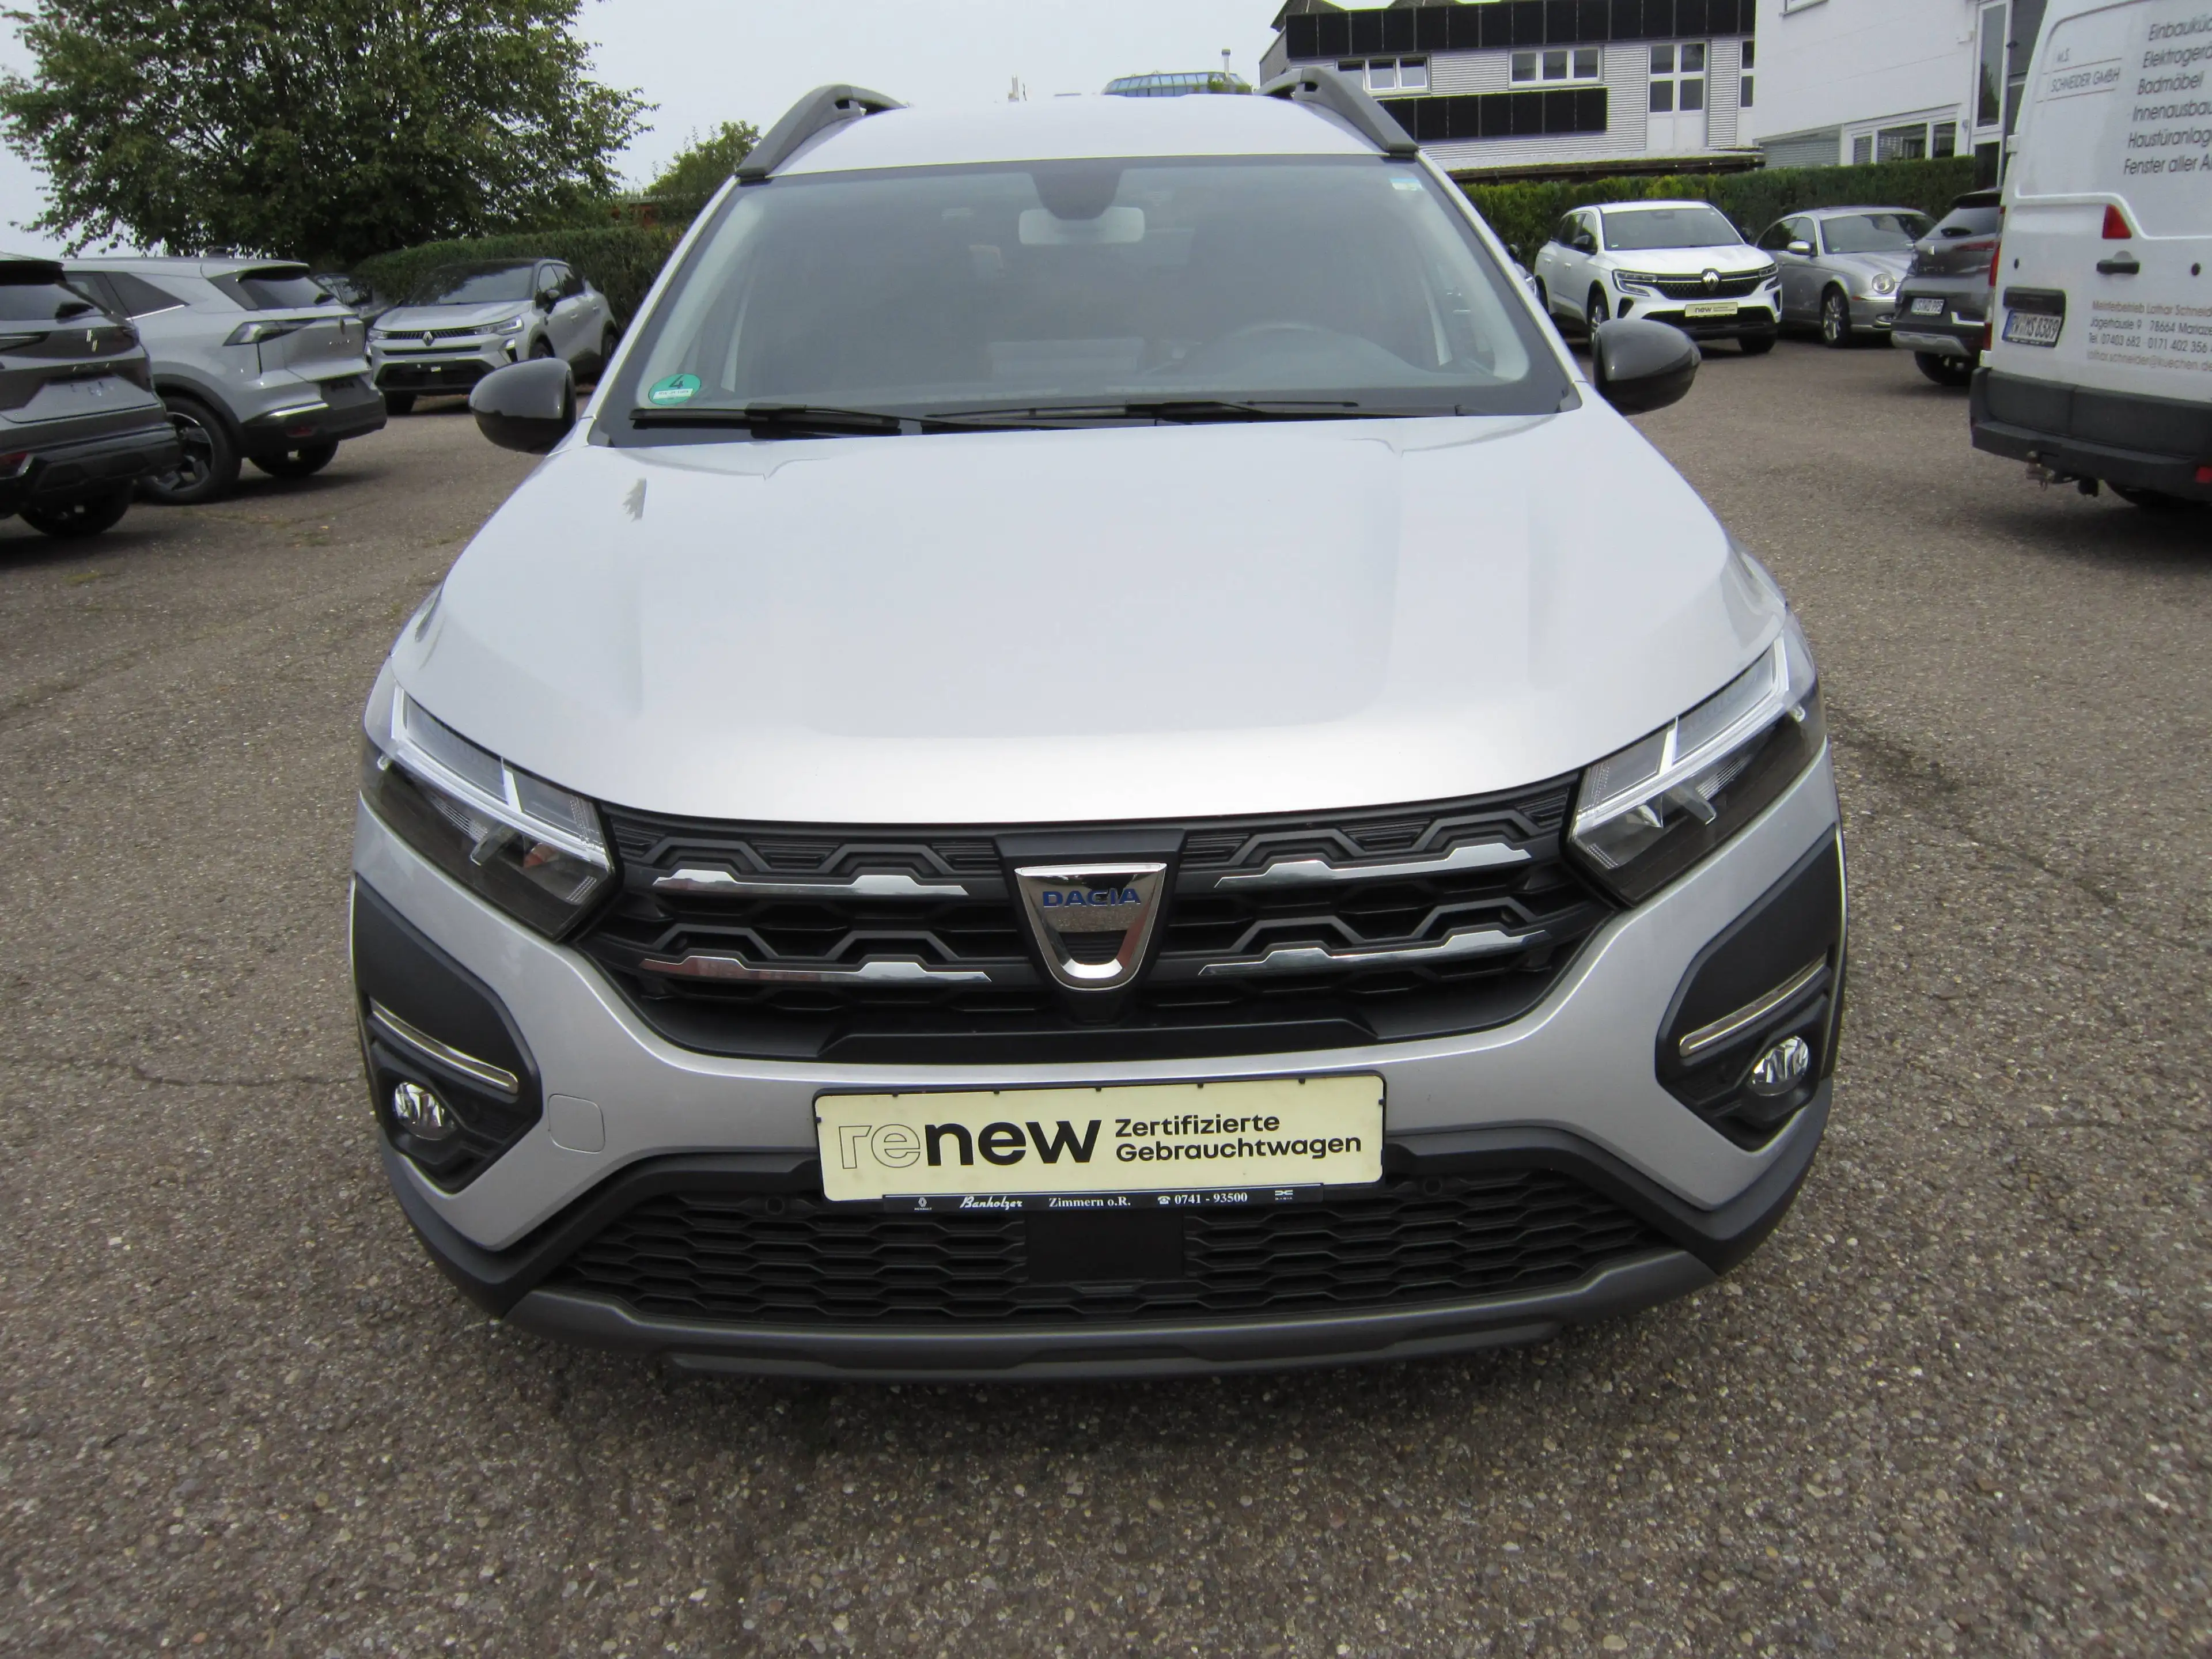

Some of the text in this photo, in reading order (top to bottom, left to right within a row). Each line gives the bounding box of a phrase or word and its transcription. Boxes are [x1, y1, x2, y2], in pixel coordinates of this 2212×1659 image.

[2138, 70, 2205, 95] Badmöbel
[2128, 127, 2212, 148] Haustüranlag
[2124, 156, 2166, 175] Fenster
[2169, 154, 2198, 173] aller
[2146, 303, 2173, 315] Lothar
[2137, 319, 2142, 329] 9
[2150, 320, 2175, 332] 78664
[2101, 334, 2124, 346] 07403
[2148, 338, 2168, 349] 0171
[2171, 339, 2188, 351] 402
[2191, 340, 2207, 353] 356
[669, 374, 684, 389] 4
[1041, 888, 1141, 908] DACIA
[1115, 1114, 1280, 1137] Zertifizierte
[839, 1119, 1102, 1169] renew
[1116, 1137, 1361, 1162] Gebrauchtwagen
[960, 1195, 1022, 1210] Banholzer
[1048, 1198, 1104, 1207] Zimmern
[1107, 1196, 1131, 1206] o.R.
[1175, 1194, 1201, 1205] 0741
[1213, 1192, 1248, 1203] 93500
